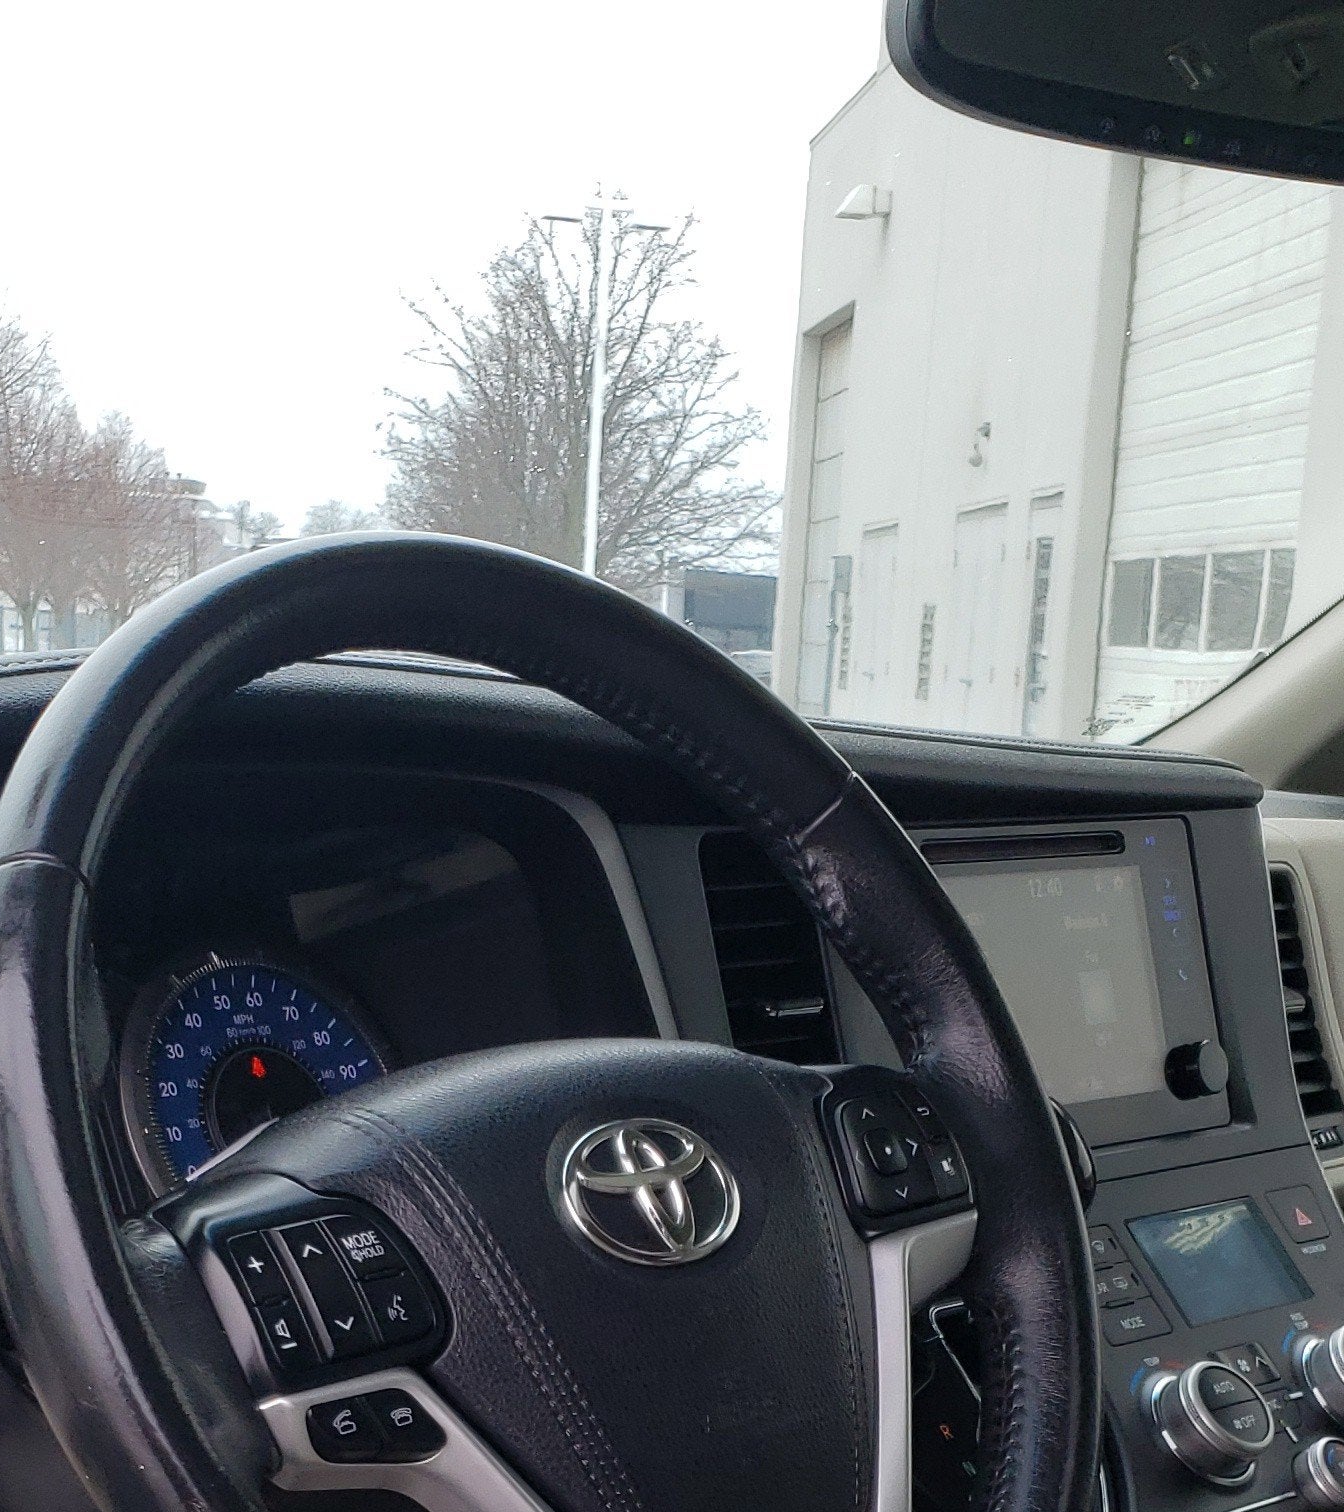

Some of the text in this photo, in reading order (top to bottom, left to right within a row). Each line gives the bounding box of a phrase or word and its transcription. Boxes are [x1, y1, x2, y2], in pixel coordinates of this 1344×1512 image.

[212, 994, 232, 1011] 50
[244, 991, 264, 1009] 60
[184, 1012, 203, 1029] 40
[232, 1014, 255, 1026] MPH
[282, 1005, 300, 1022] 70
[312, 1029, 332, 1047] 80
[165, 1042, 185, 1060] 30
[338, 1063, 358, 1081] 90
[159, 1081, 178, 1099] 20
[165, 1126, 183, 1143] 10
[341, 1231, 381, 1251] MODE
[359, 1244, 385, 1260] HOLD
